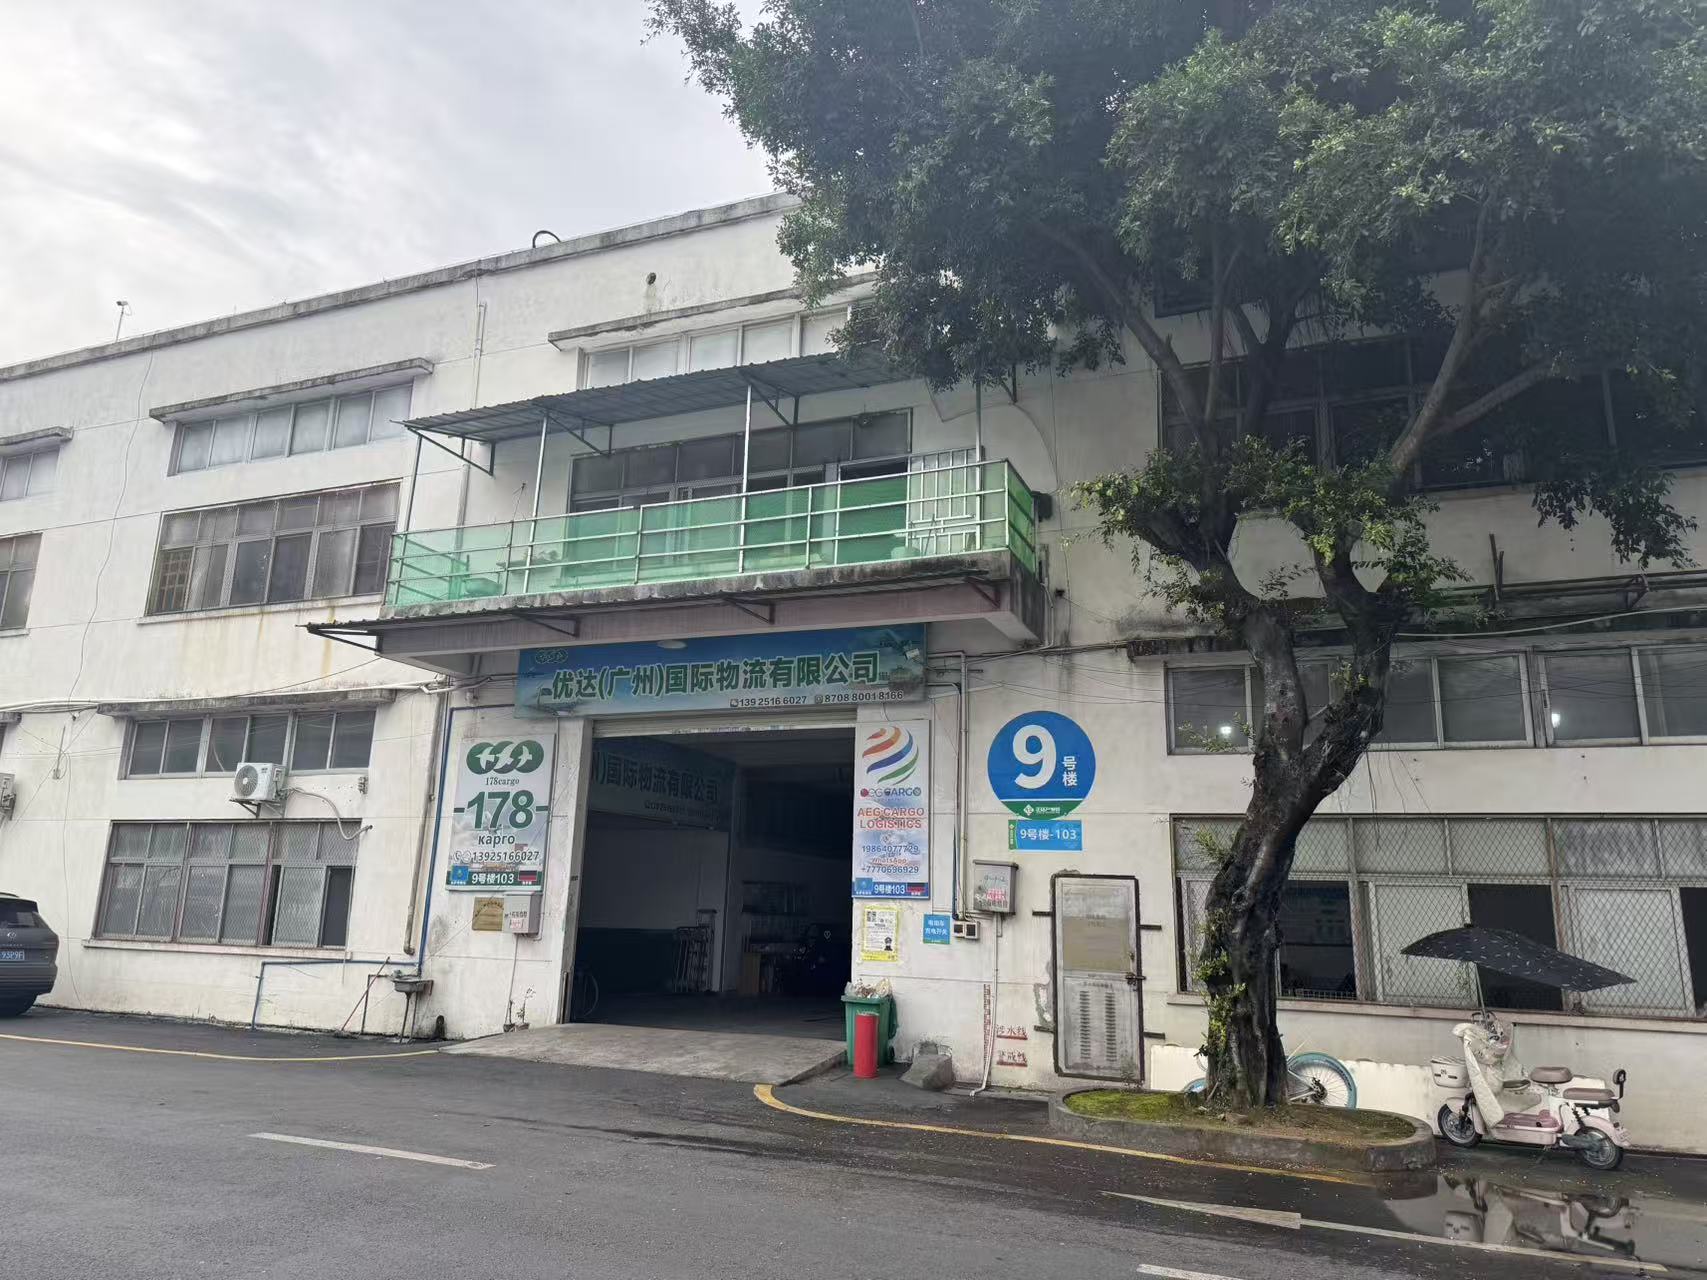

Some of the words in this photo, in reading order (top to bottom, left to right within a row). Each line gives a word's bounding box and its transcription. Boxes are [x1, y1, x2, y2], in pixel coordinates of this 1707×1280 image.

[551, 650, 881, 700] 优达(广州)国际物流有限公司
[1013, 724, 1057, 789] 9
[1062, 756, 1078, 787] 号楼
[485, 776, 520, 786] 178cargo
[857, 807, 881, 817] AEG
[883, 807, 925, 817] CARGO
[860, 819, 922, 829] LOGISTICS
[478, 834, 516, 847] карго
[472, 850, 540, 863] 13925166027
[471, 873, 514, 885] 9号楼103
[873, 884, 905, 894] 9号楼103
